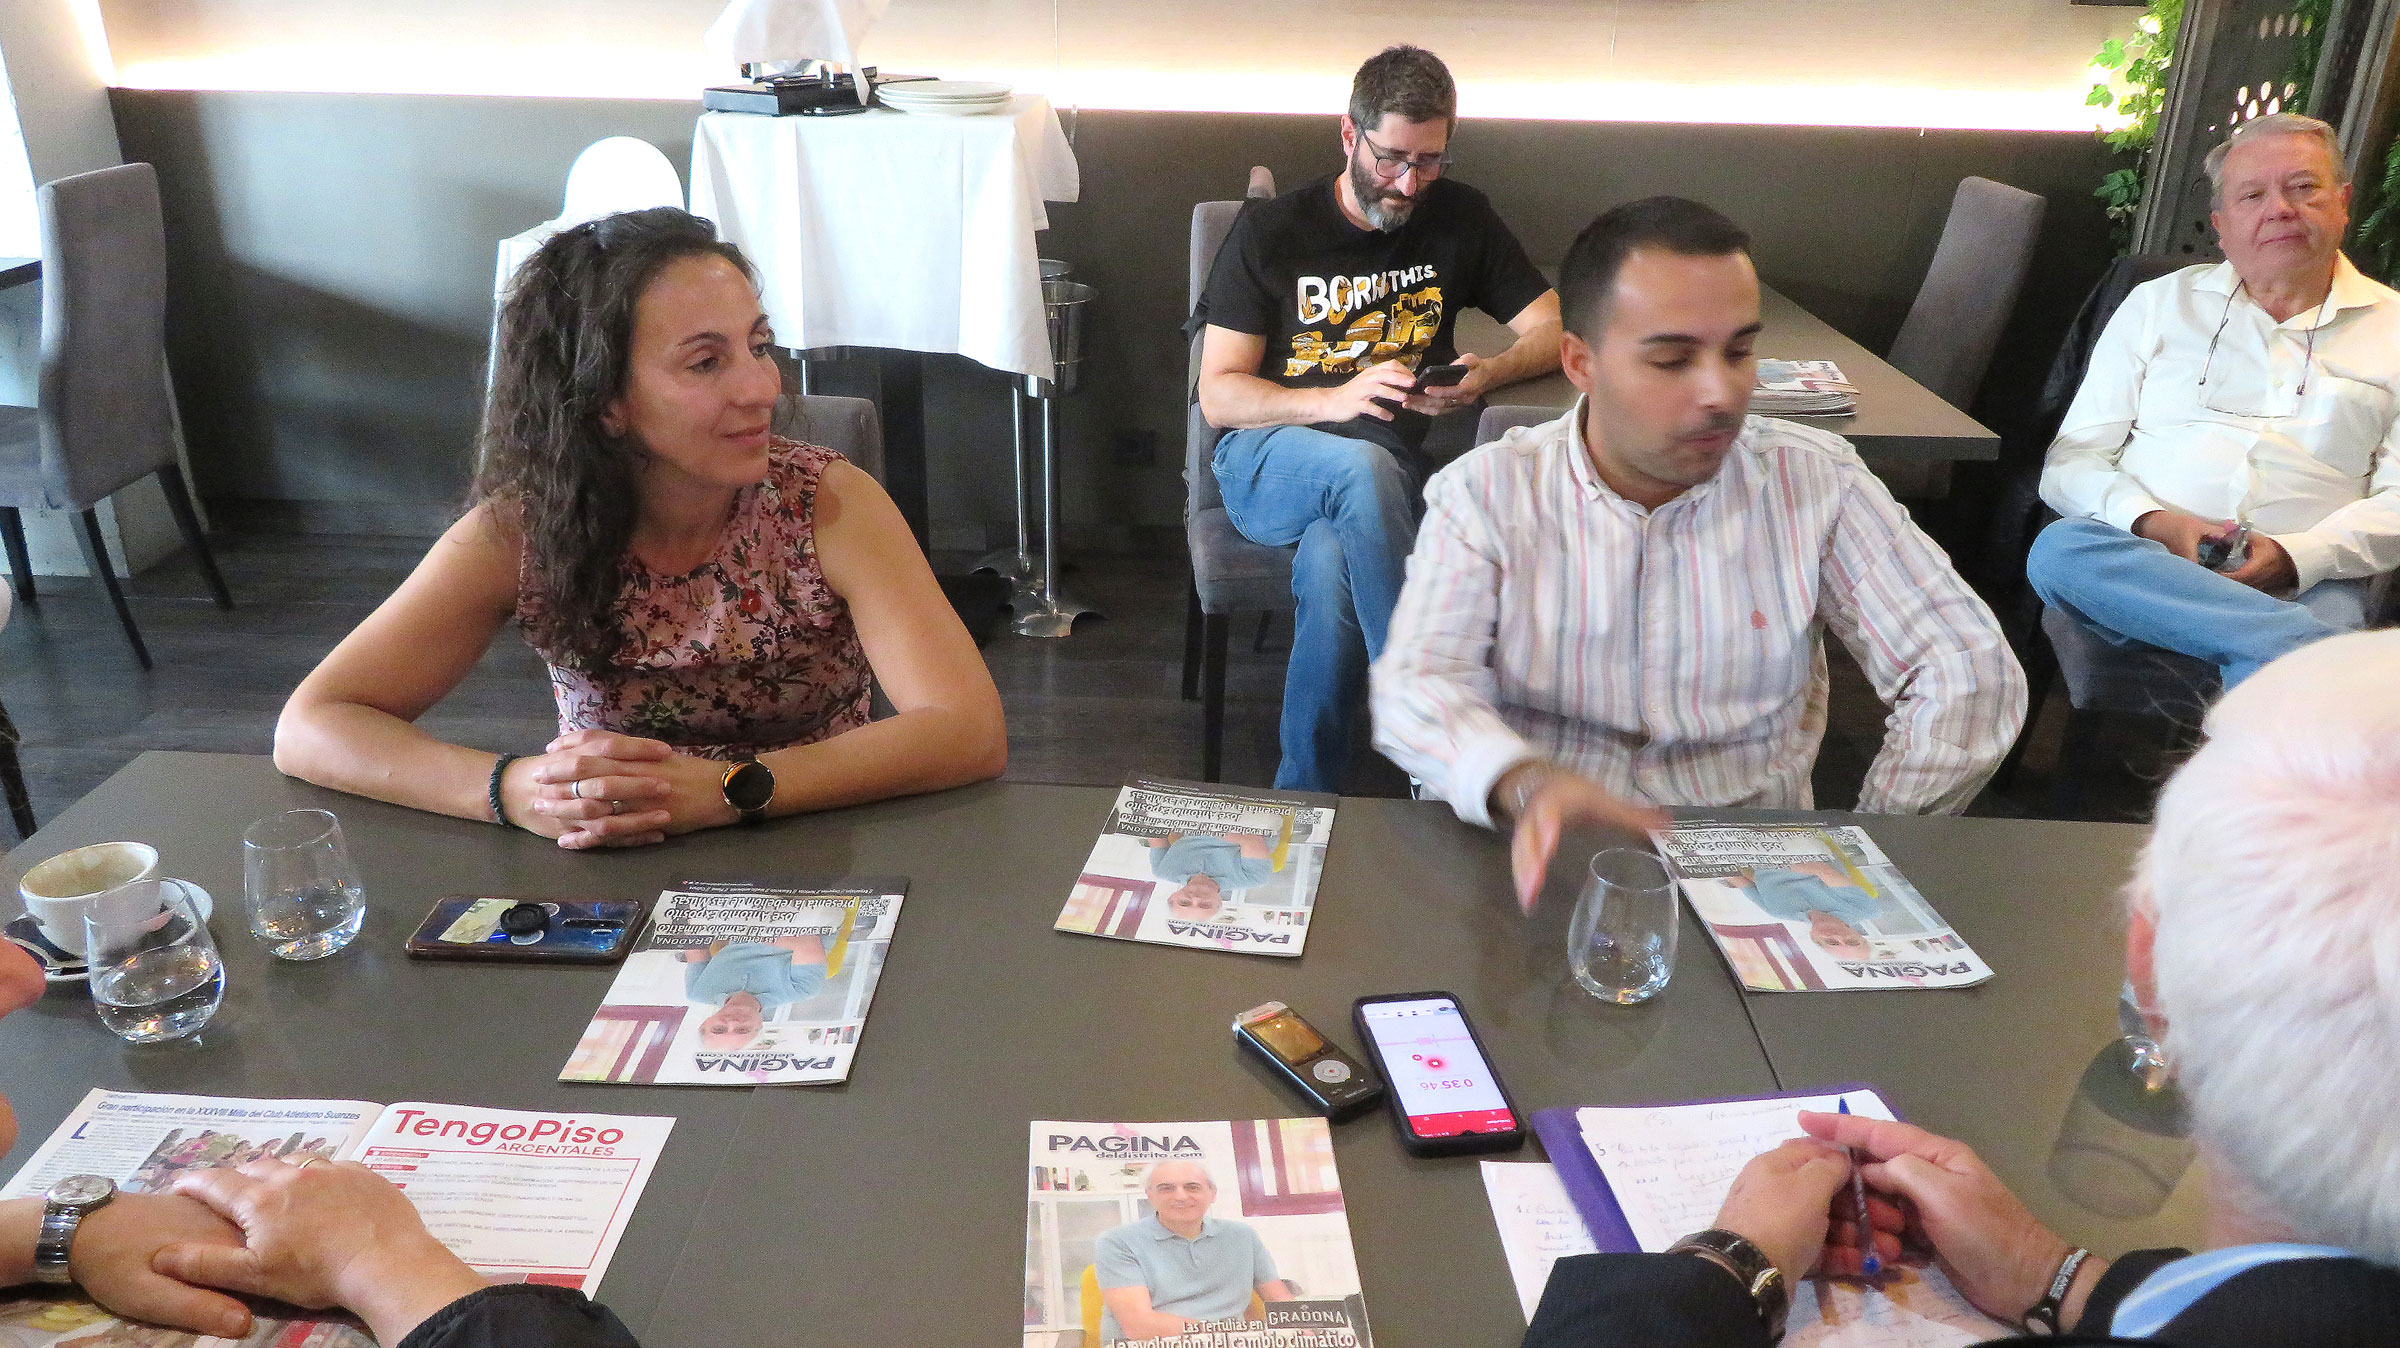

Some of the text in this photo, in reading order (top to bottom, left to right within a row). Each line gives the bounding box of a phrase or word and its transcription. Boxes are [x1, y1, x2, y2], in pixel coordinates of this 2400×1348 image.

[1297, 264, 1437, 325] BORN THIS
[1130, 790, 1162, 804] Musas
[1179, 797, 1194, 808] de
[1125, 800, 1242, 822] José Antonio Expósito
[1194, 798, 1234, 812] rebelión
[1236, 804, 1246, 812] la
[1248, 804, 1292, 816] presenta
[1118, 822, 1170, 836] GRADONA
[1119, 812, 1274, 838] La evolución del cambio climático
[1713, 830, 1725, 841] de
[1726, 830, 1770, 841] rebelión
[1716, 841, 1760, 852] Antonio
[1675, 854, 1720, 864] climático
[1720, 854, 1755, 863] cambio
[1686, 864, 1737, 874] GRADONA
[670, 895, 856, 910] presenta la rebelión de Las Musas
[664, 907, 798, 923] José Antonio Expósito
[657, 924, 833, 936] La evolución del cambio climático
[1167, 923, 1290, 944] PAGINA
[655, 935, 713, 945] GRADONA
[729, 934, 762, 944] Tertulias
[761, 935, 777, 944] Las
[1841, 961, 1972, 978] PAGINA
[694, 1056, 836, 1073] PAGINA
[97, 1101, 118, 1111] Gran
[118, 1102, 175, 1115] participación
[186, 1106, 196, 1114] la
[228, 1108, 247, 1118] Milla
[248, 1109, 262, 1118] del
[263, 1110, 284, 1119] Club
[284, 1110, 324, 1120] Atletismo
[324, 1110, 361, 1121] Suanzes
[395, 1110, 624, 1146] TengoPiso
[495, 1142, 616, 1156] ARCENTALES
[1048, 1134, 1201, 1152] PAGINA
[1096, 1150, 1204, 1160] deldistrito.com
[1182, 1310, 1346, 1334] Las Tertulias en GRADONA
[1205, 1332, 1228, 1348] del
[1232, 1331, 1285, 1348] cambio
[1288, 1328, 1354, 1348] climático
